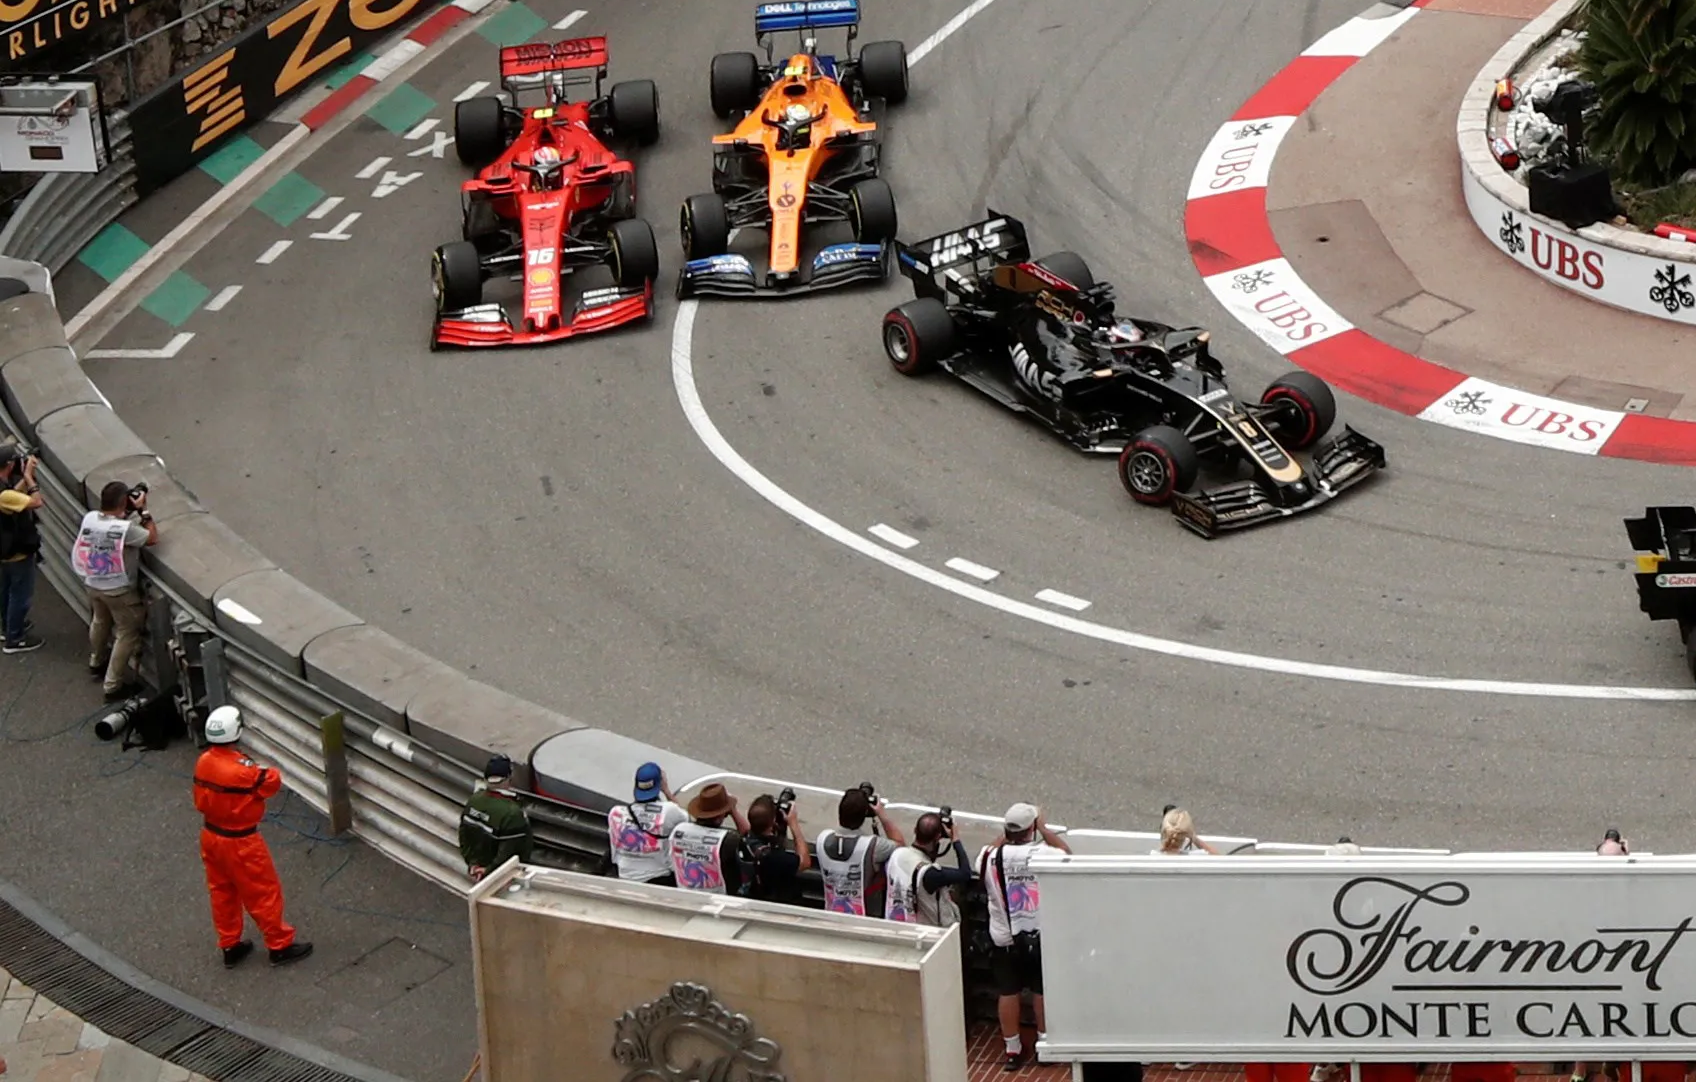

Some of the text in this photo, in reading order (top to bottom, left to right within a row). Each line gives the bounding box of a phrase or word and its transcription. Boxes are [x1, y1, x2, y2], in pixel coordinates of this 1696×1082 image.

[765, 2, 792, 14] DELL
[1209, 143, 1260, 190] UBS
[528, 247, 555, 266] 16
[1528, 228, 1605, 291] UBS
[1254, 289, 1330, 342] UBS
[1499, 401, 1606, 443] UBS
[685, 852, 710, 862] PHOTO
[1284, 1002, 1491, 1039] MONTE
